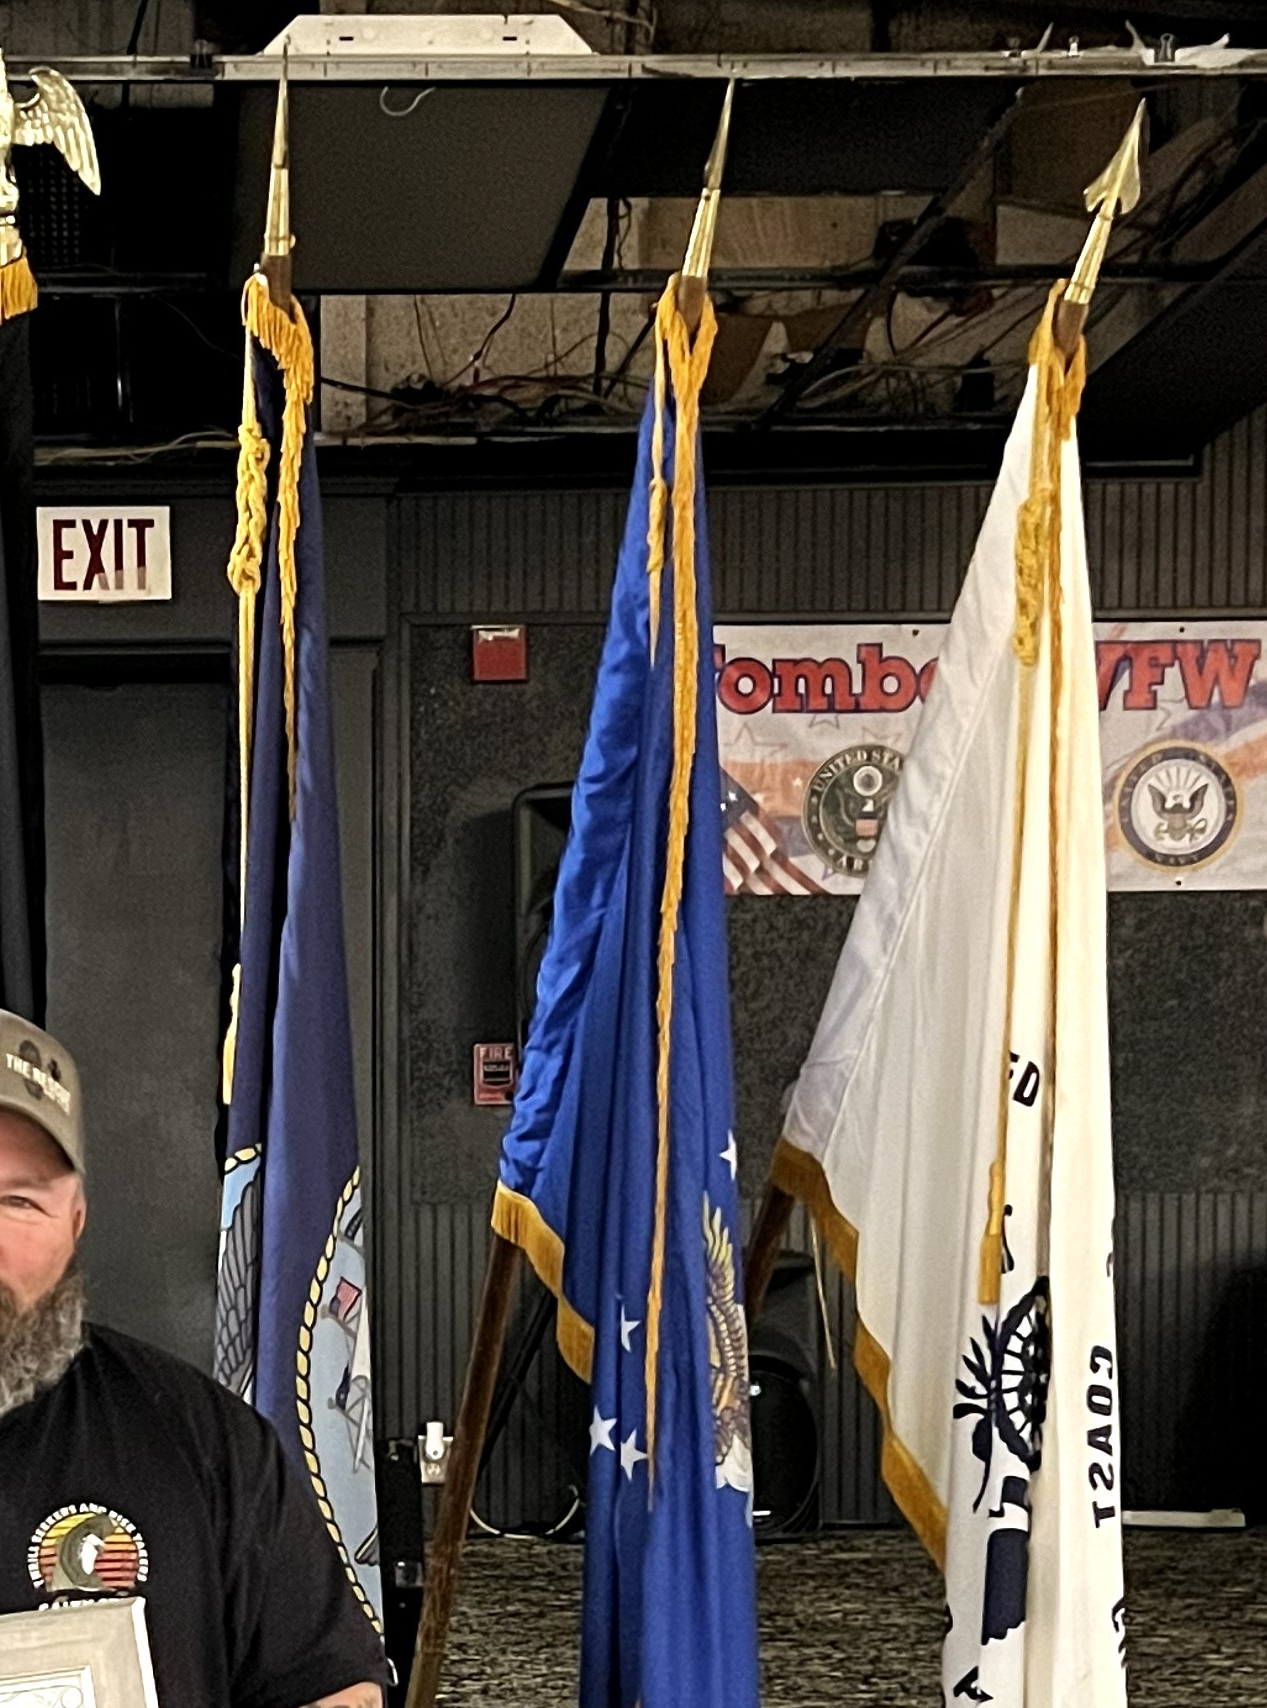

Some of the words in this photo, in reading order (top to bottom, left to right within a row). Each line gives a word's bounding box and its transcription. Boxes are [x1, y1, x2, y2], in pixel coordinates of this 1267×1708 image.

[52, 518, 155, 592] EXIT
[1095, 639, 1261, 712] VFW
[813, 750, 868, 792] UNITED
[479, 1047, 513, 1060] FIRE
[80, 1503, 107, 1514] AND
